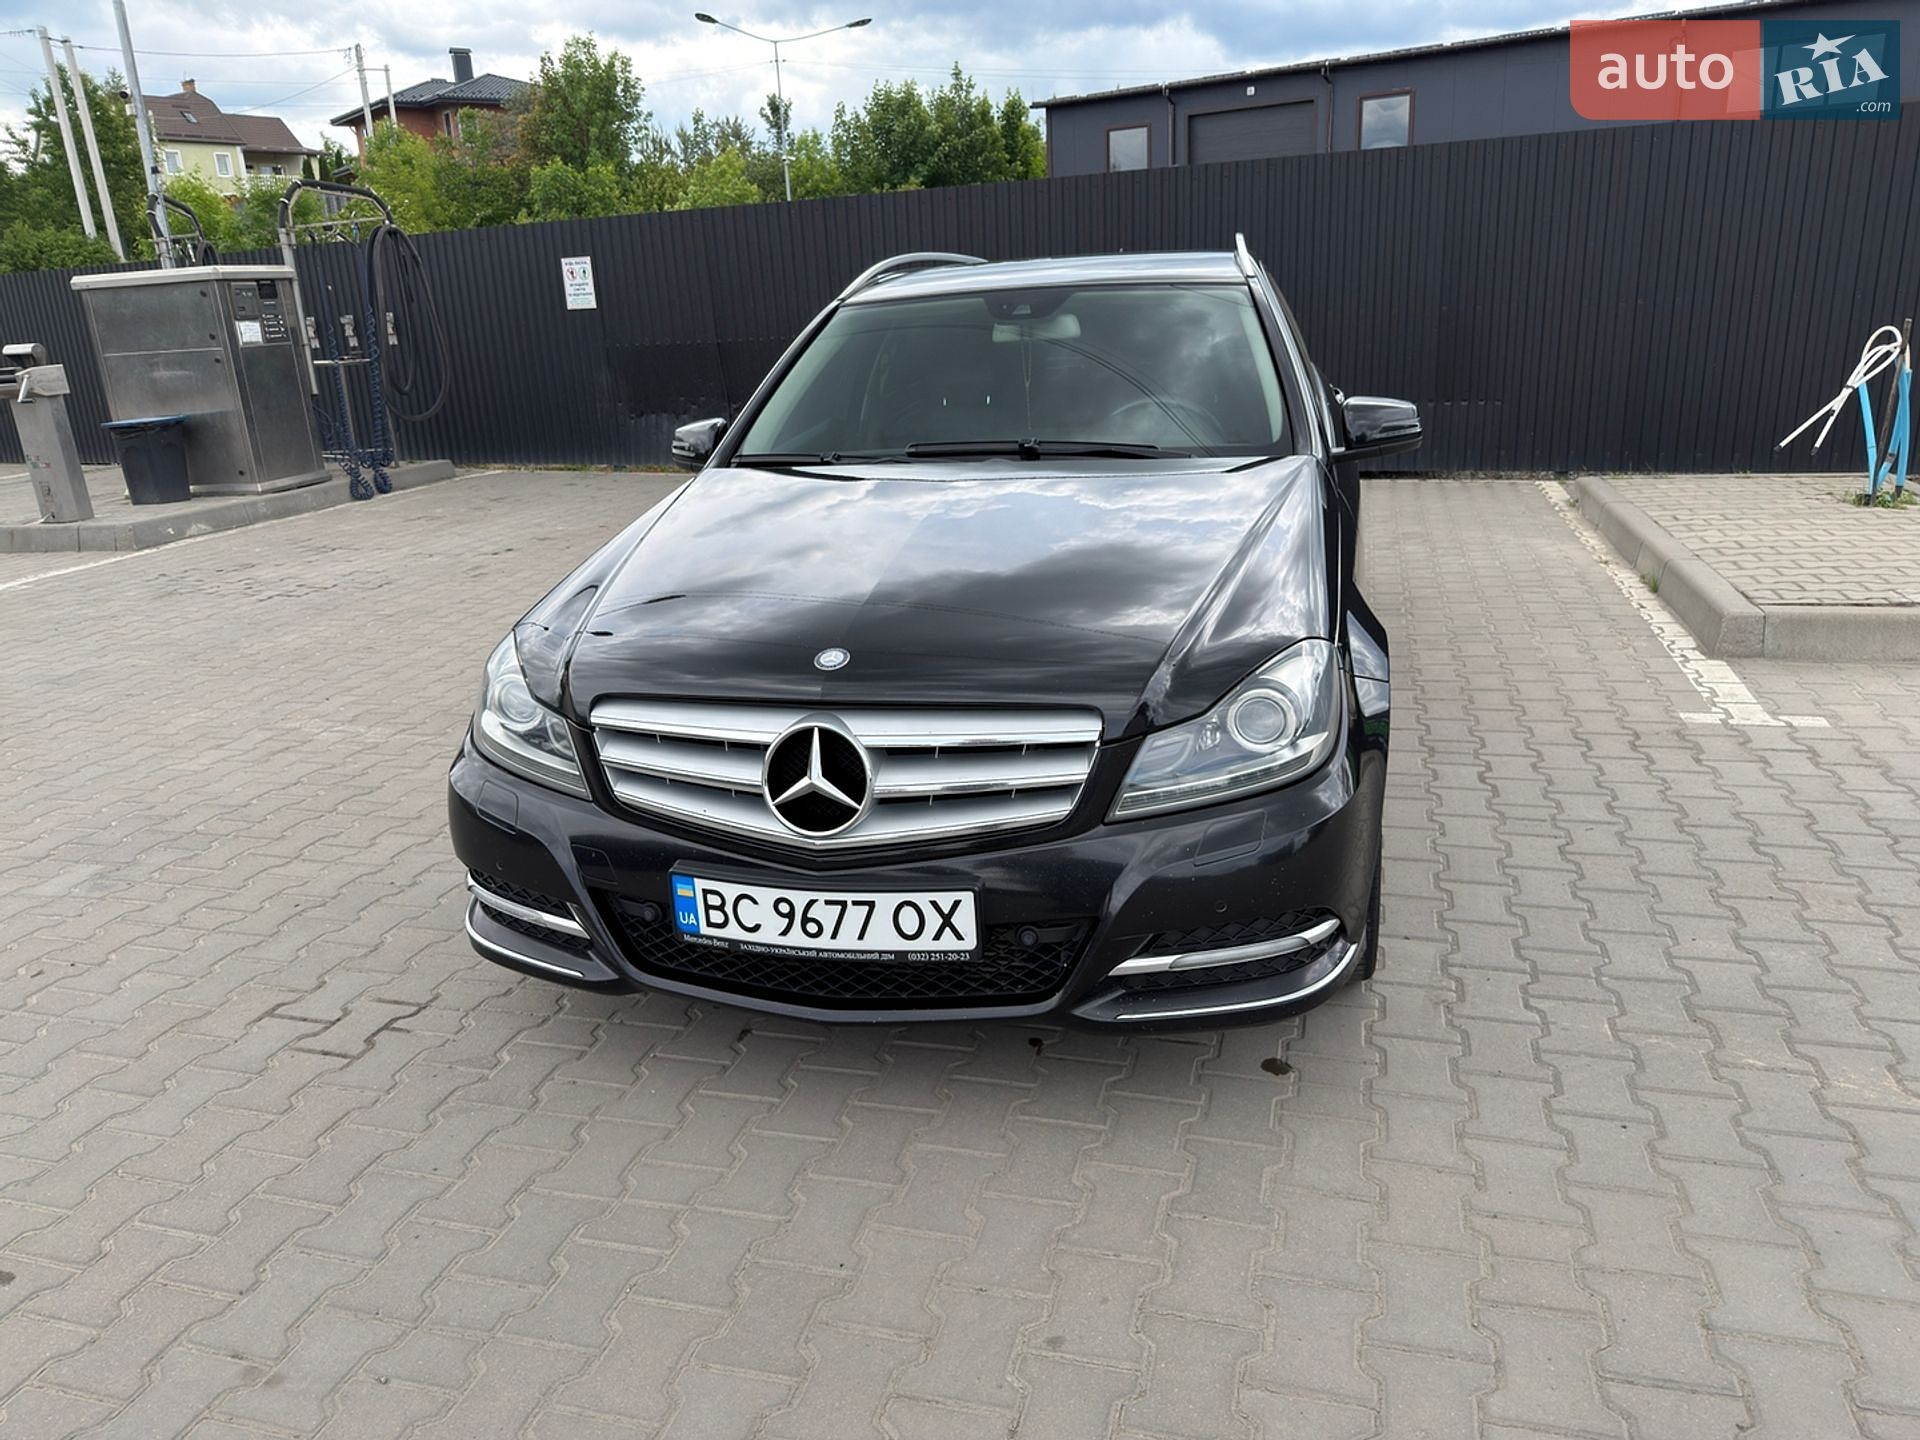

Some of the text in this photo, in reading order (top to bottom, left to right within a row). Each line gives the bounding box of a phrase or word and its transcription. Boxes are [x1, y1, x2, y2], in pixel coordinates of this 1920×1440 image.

[679, 911, 698, 926] UA
[701, 888, 966, 942] BC 9677 OX
